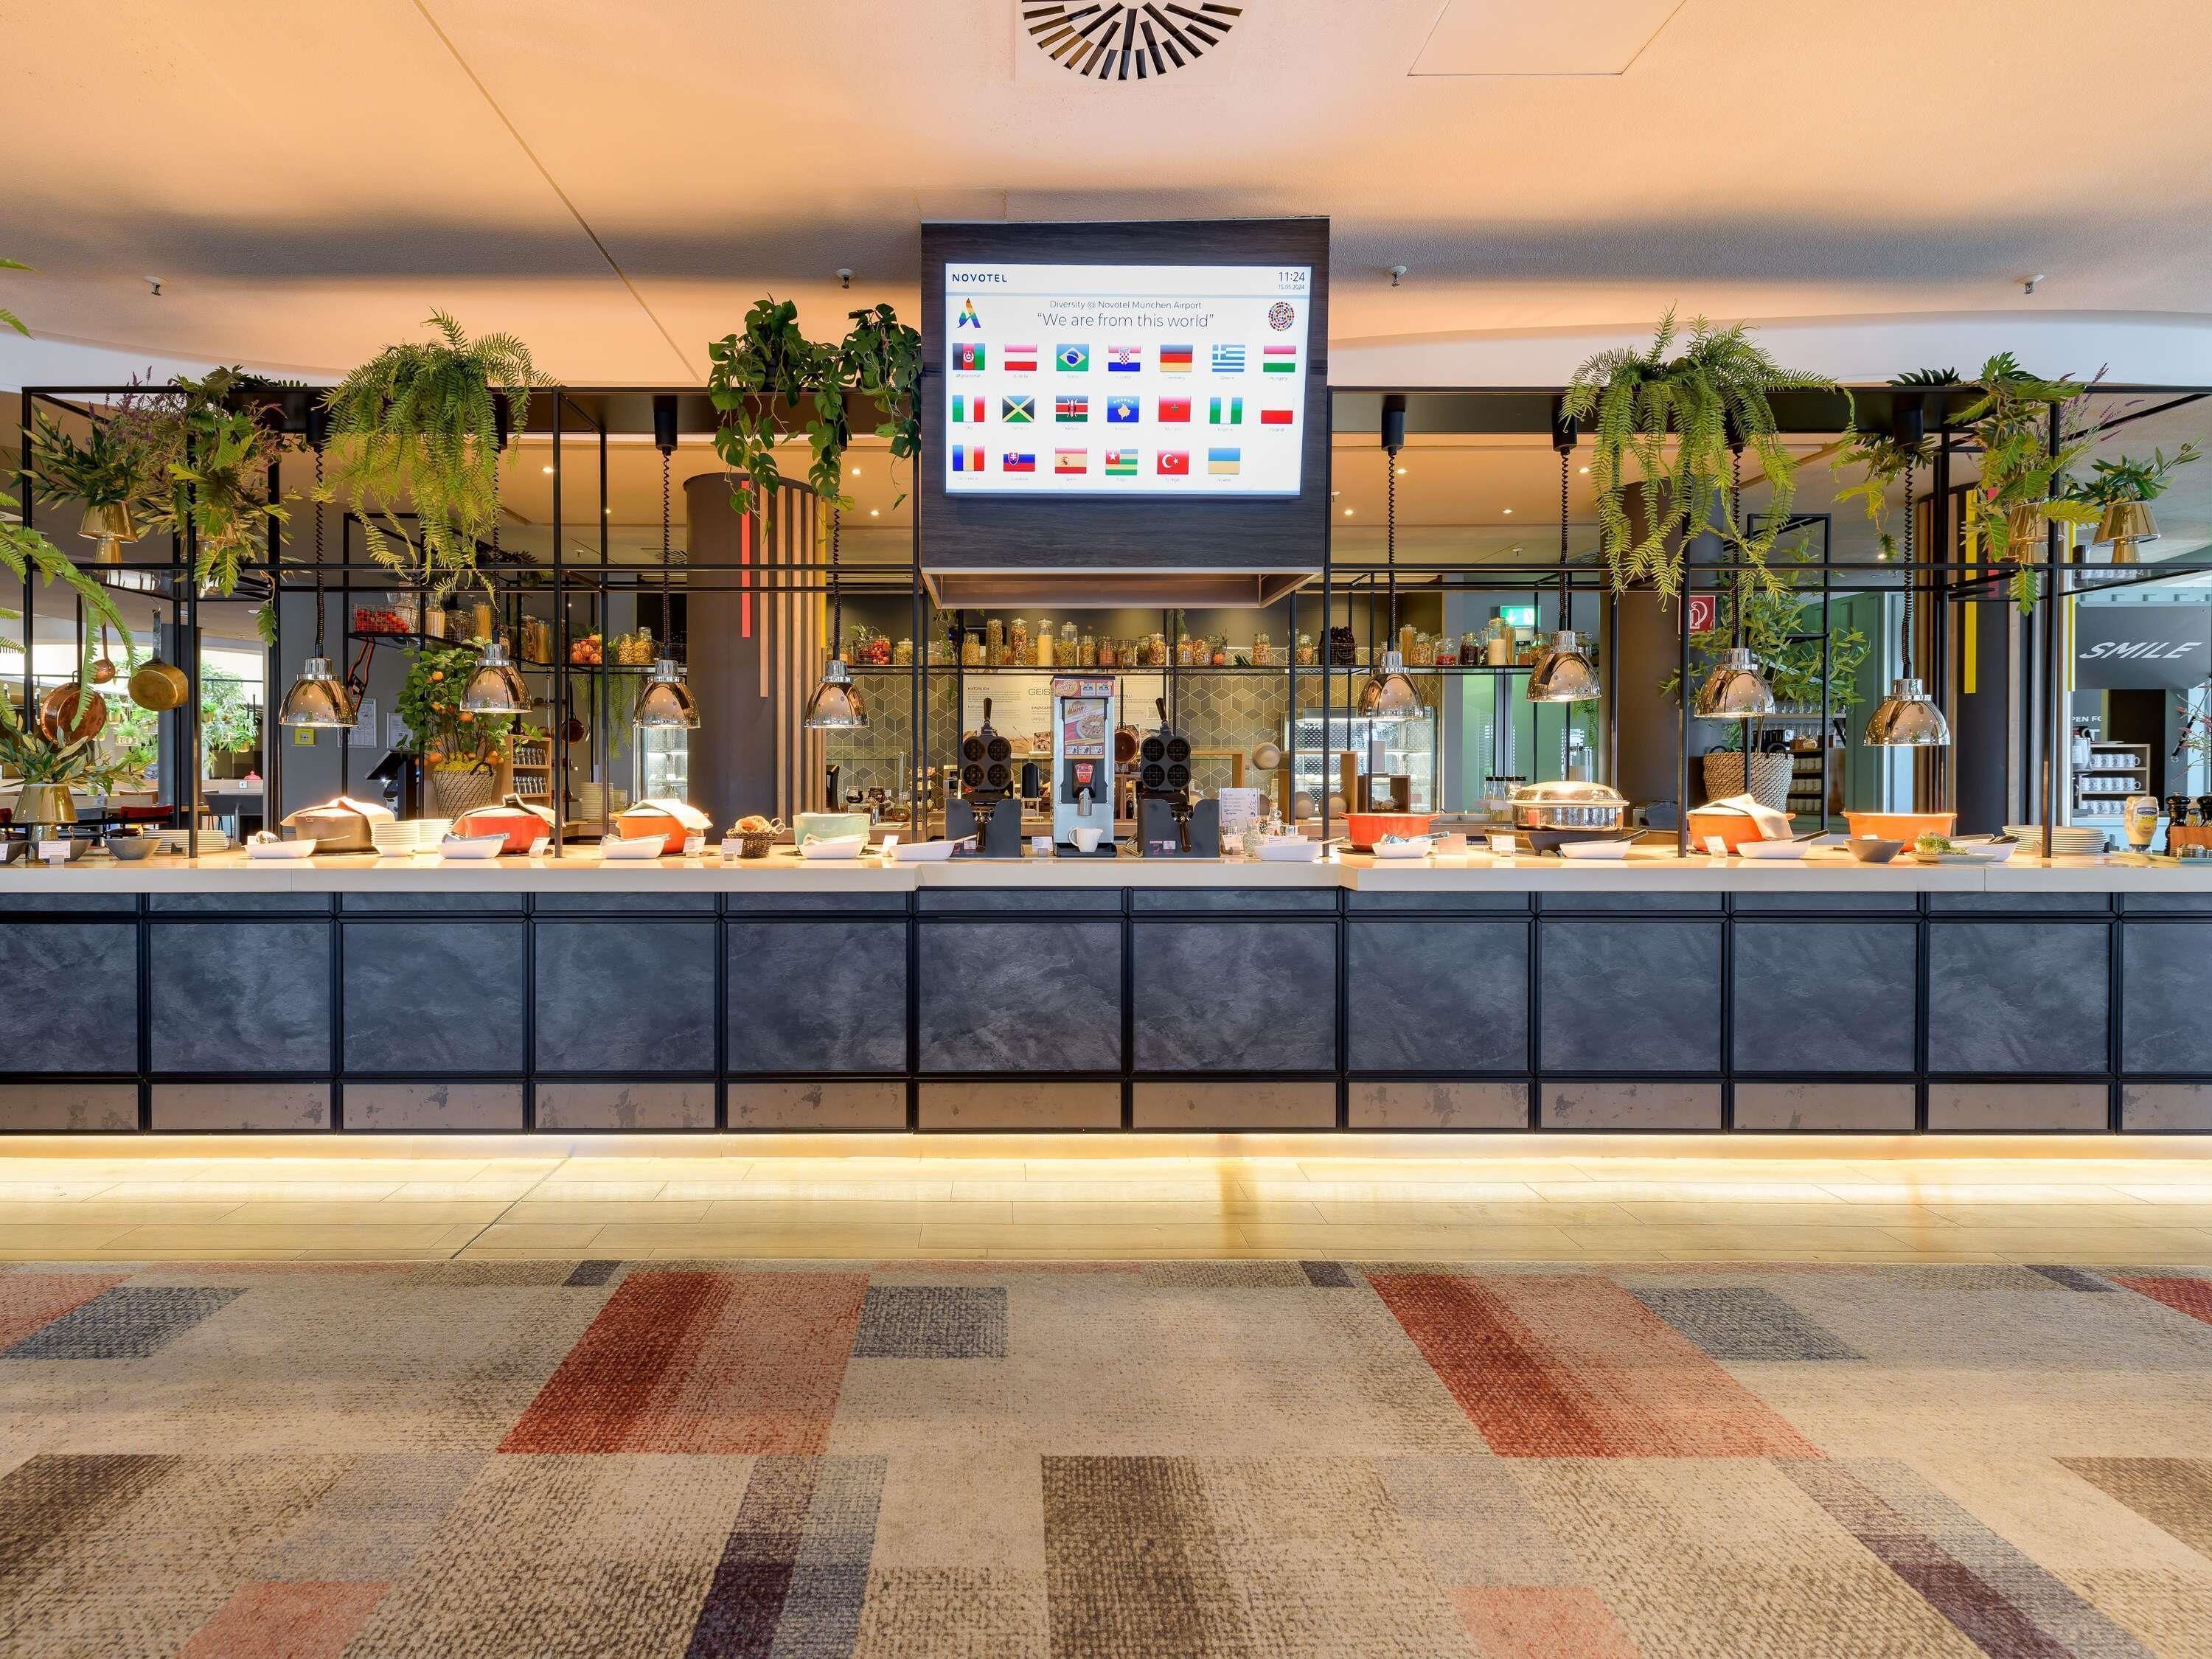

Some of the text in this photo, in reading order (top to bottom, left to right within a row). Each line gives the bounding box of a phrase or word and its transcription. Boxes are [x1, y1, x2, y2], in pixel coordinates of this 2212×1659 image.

[952, 274, 1007, 282] NOVOTEL
[1278, 271, 1305, 282] 11:24
[1050, 300, 1085, 310] Diversity
[1087, 301, 1096, 309] @
[1098, 300, 1130, 308] Novotel
[1173, 301, 1202, 310] Airport
[1071, 316, 1094, 326] are
[1098, 313, 1133, 326] from
[1137, 313, 1164, 327] this
[2079, 641, 2203, 658] SMILE
